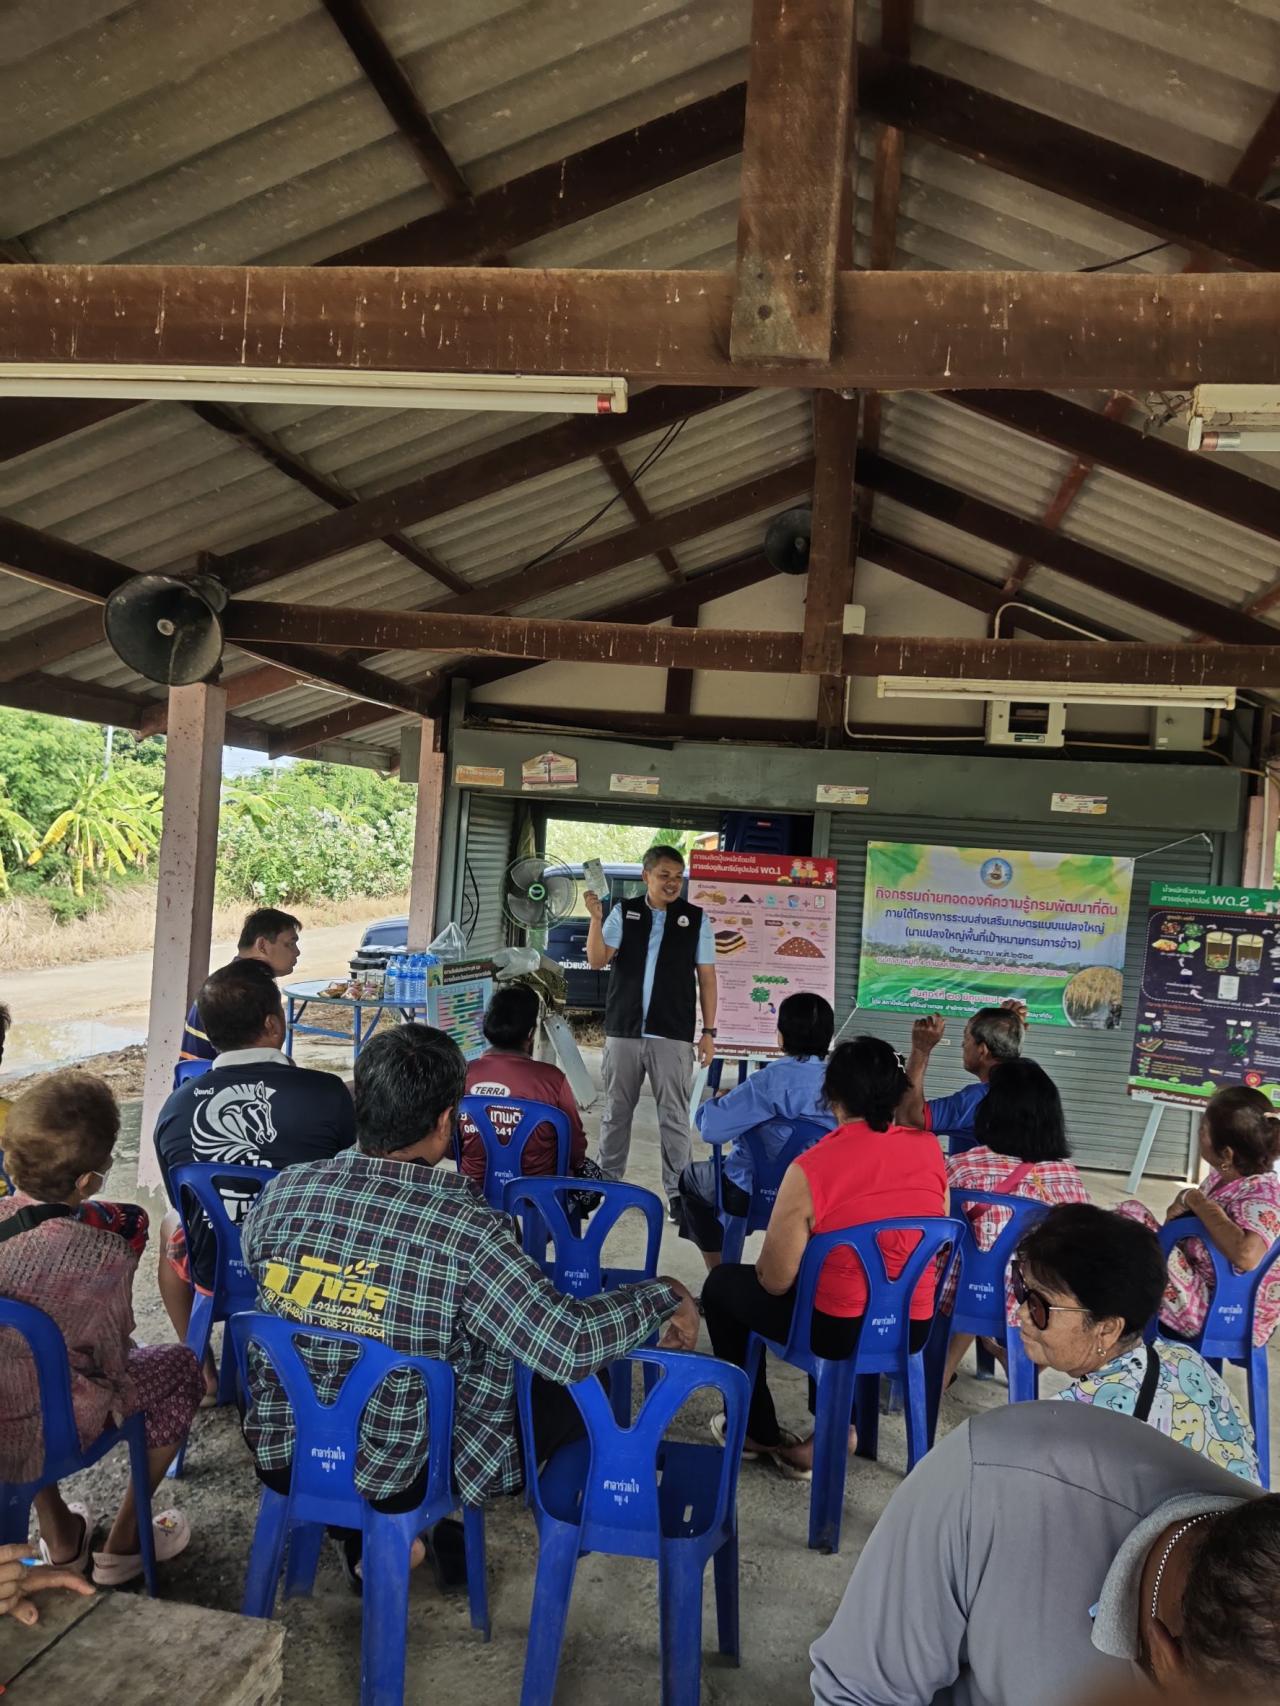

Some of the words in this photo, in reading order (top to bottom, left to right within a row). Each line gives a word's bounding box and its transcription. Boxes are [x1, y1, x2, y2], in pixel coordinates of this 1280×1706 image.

[875, 886, 1118, 916] กิจกรรมถ่ายทอดองค์ความรู้กรมพัฒนาที่ดิน
[885, 908, 1105, 935] ภายใต้โครงการระบบส่งเสริมเกษตรแบบแปลงใหญ่
[905, 926, 1081, 950] (นาแปลงใหญ่พื้นที่เป้าหมายกรมการข้าว)
[475, 1086, 506, 1096] TERRA
